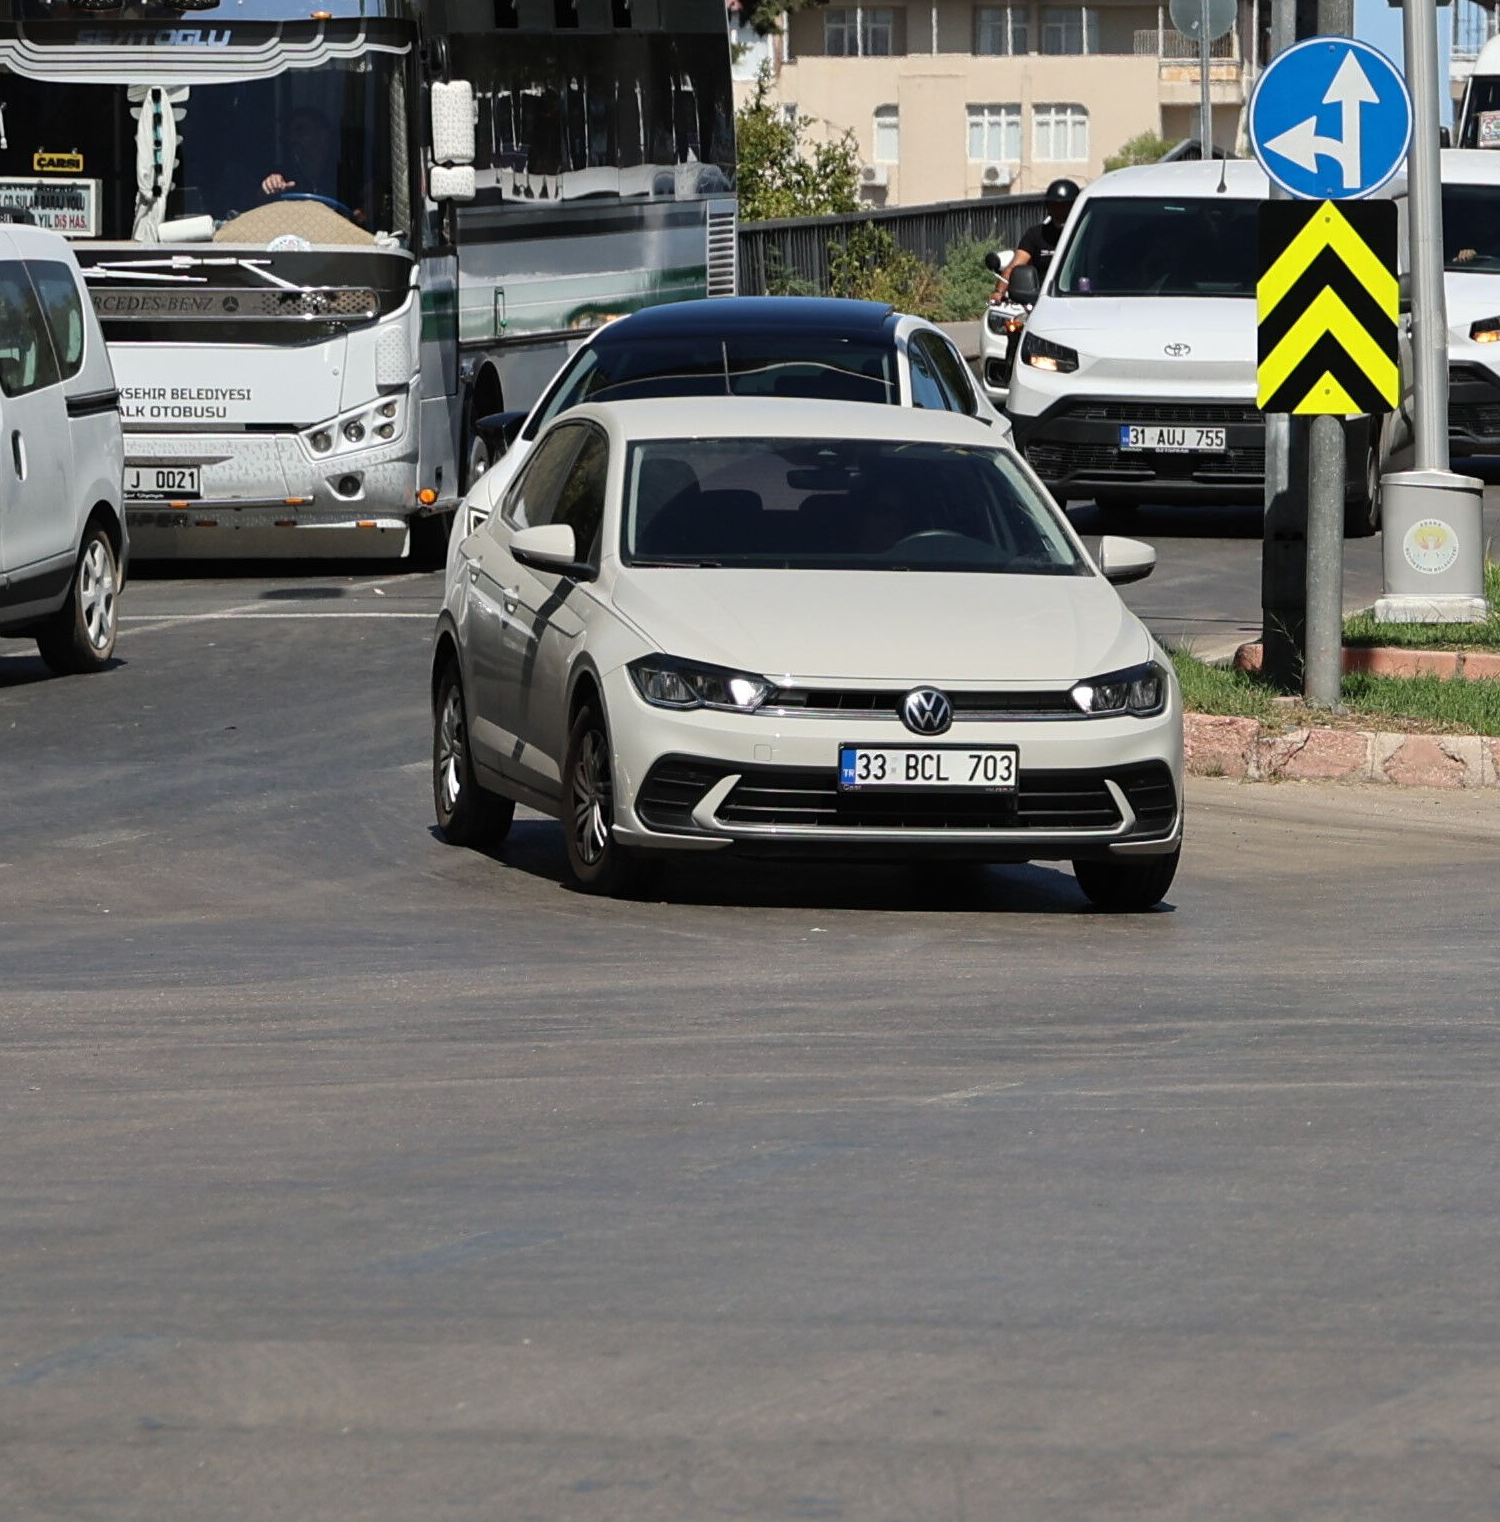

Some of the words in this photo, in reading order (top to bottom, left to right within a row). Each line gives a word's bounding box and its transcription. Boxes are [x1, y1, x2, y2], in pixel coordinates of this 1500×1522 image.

[94, 295, 213, 312] RCEDES-BENZ
[117, 387, 167, 399] KSEHIR
[170, 387, 252, 401] BELEDIYESI
[118, 405, 146, 418] ALK
[150, 405, 227, 419] OTOBUSU
[1130, 427, 1146, 445] 31
[1157, 428, 1186, 447] AUJ
[1196, 429, 1224, 448] 755
[130, 471, 141, 489] J
[156, 470, 195, 489] 0021
[842, 768, 855, 778] TR
[857, 753, 887, 781] 33
[905, 754, 950, 782] BCL
[968, 754, 1013, 782] 703
